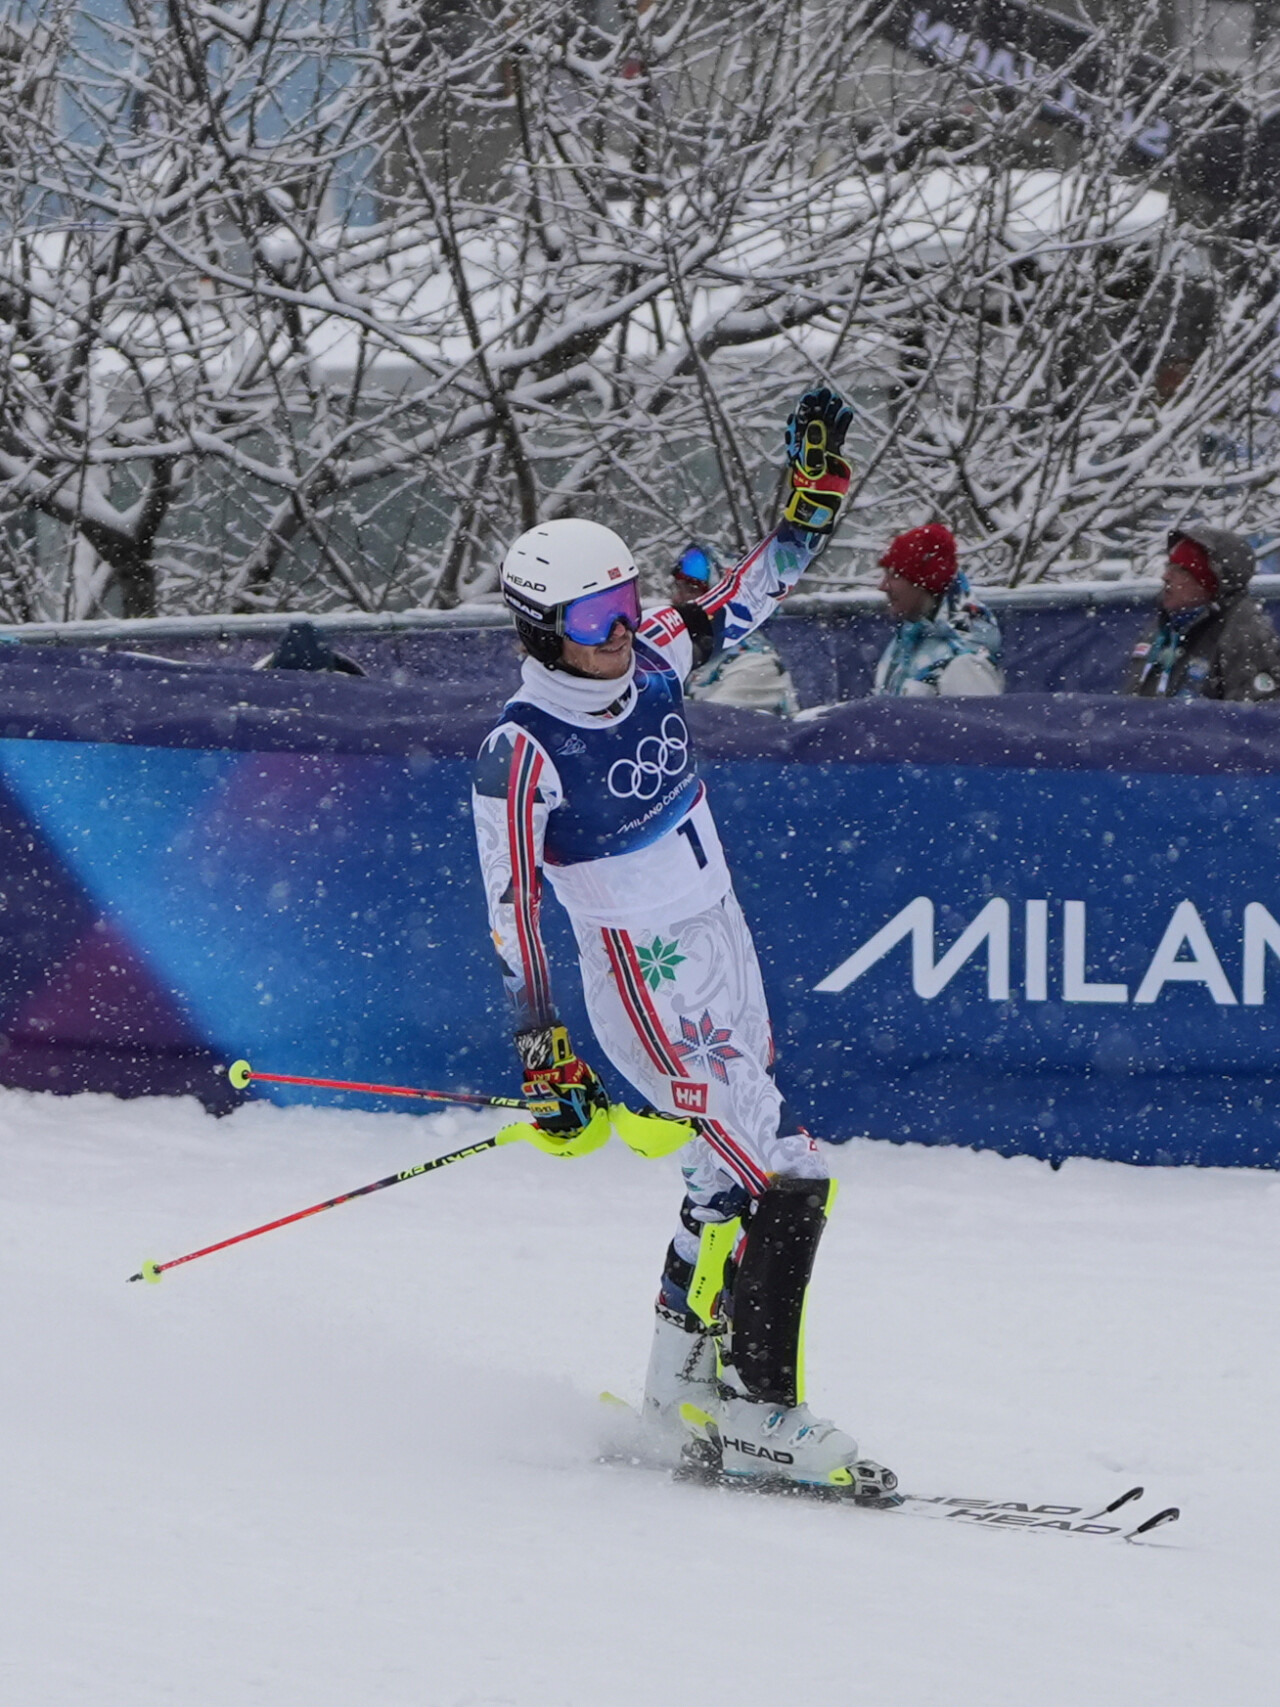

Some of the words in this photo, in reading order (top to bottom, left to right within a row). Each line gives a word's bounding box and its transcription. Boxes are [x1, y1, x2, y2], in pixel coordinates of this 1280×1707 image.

[506, 573, 547, 592] HEAD
[505, 593, 544, 620] HEAD
[616, 802, 664, 835] MILANO
[676, 817, 708, 870] 1
[490, 1096, 528, 1107] EKI
[675, 1087, 702, 1108] HH
[723, 1435, 795, 1466] HEAD
[946, 1509, 1122, 1535] HEAD
